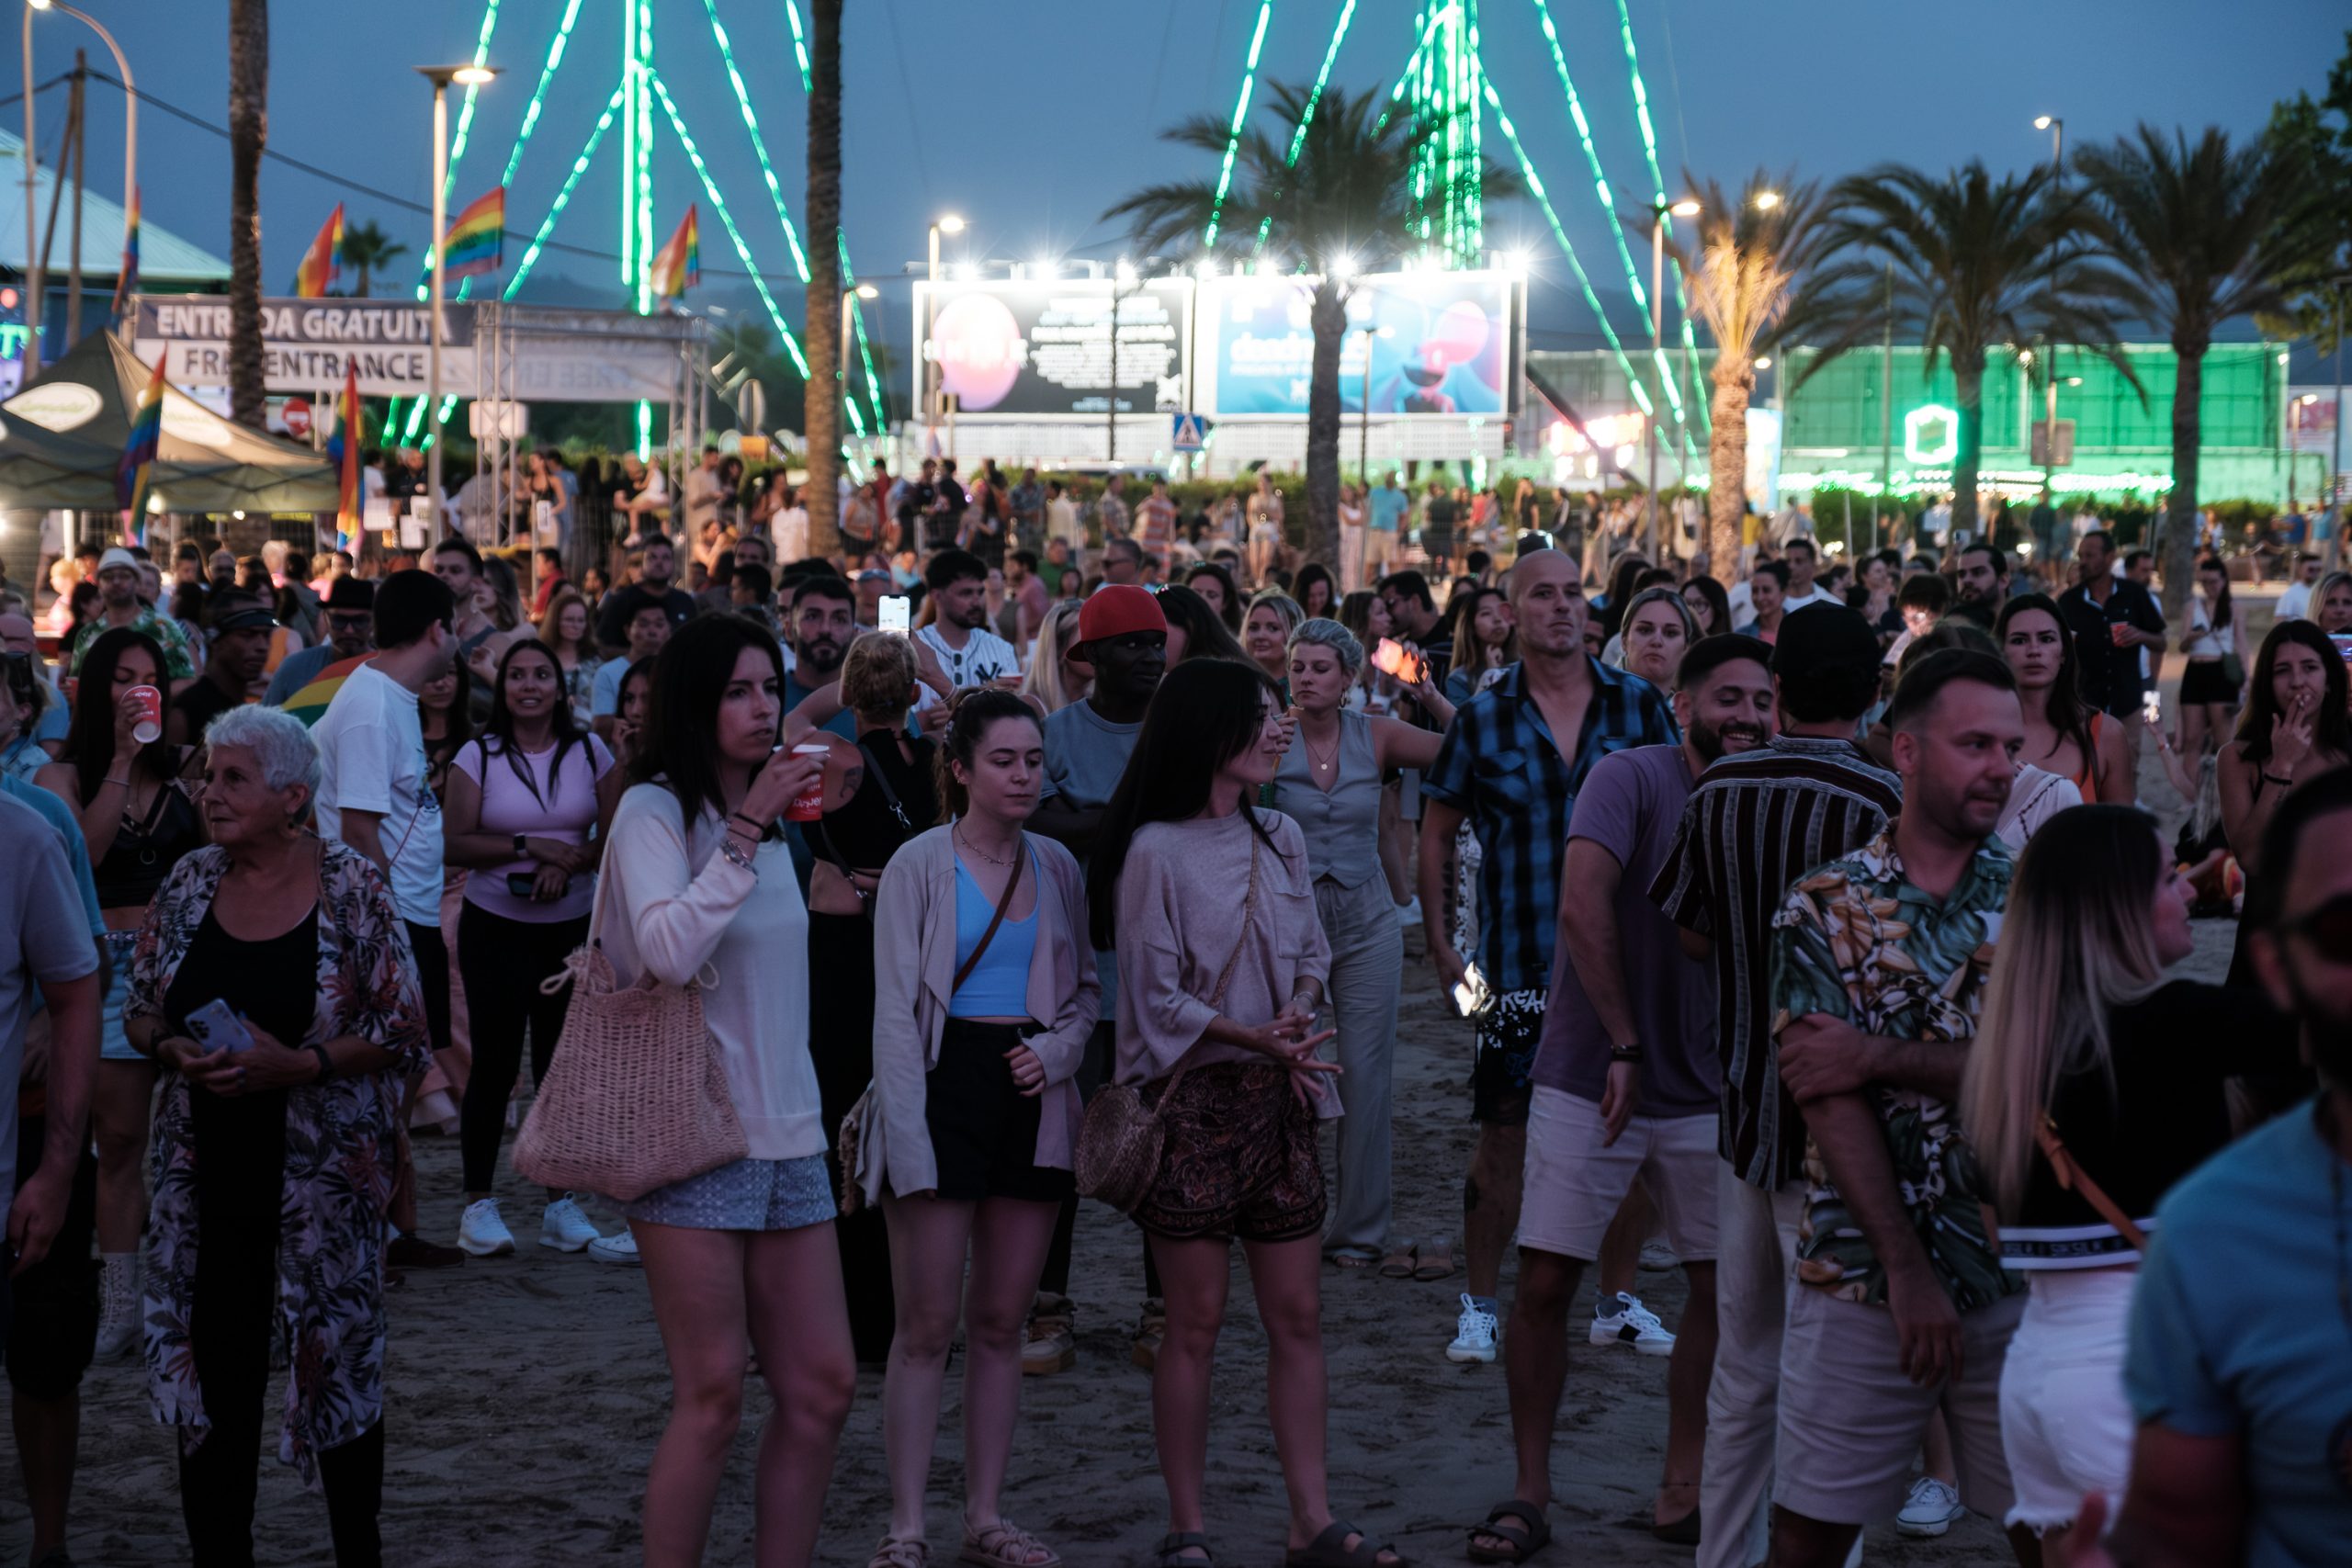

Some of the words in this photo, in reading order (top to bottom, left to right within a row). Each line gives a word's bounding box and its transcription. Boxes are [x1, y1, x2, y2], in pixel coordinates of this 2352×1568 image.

[157, 305, 297, 340] ENTRDA
[186, 347, 232, 376] FRE
[262, 349, 425, 381] ENTRANCE
